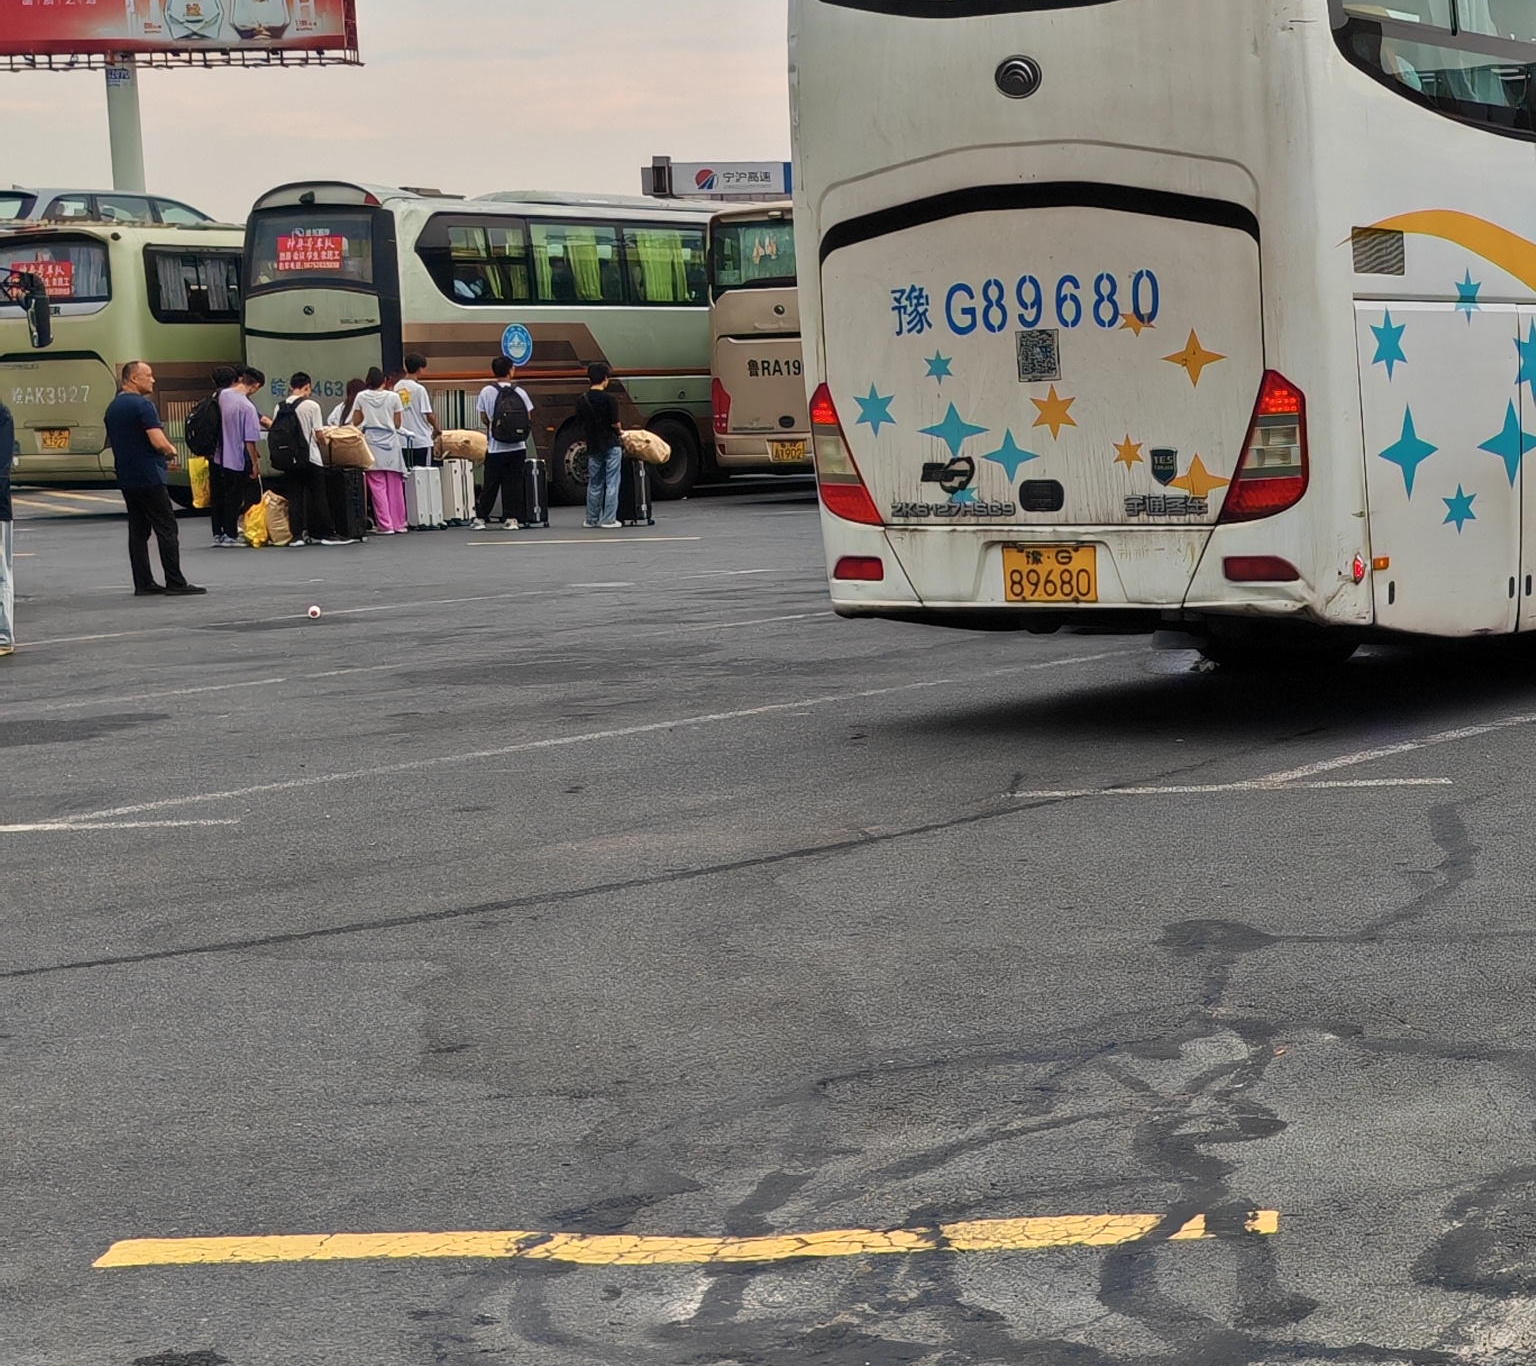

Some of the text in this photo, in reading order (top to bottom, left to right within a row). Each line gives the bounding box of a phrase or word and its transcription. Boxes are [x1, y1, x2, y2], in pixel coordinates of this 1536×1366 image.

[722, 171, 771, 183] 宁沪高速
[890, 269, 1159, 336] 豫G89680
[748, 359, 804, 377] 鲁RA19
[1124, 493, 1209, 517] 宇通客车
[1010, 568, 1091, 597] 89680
